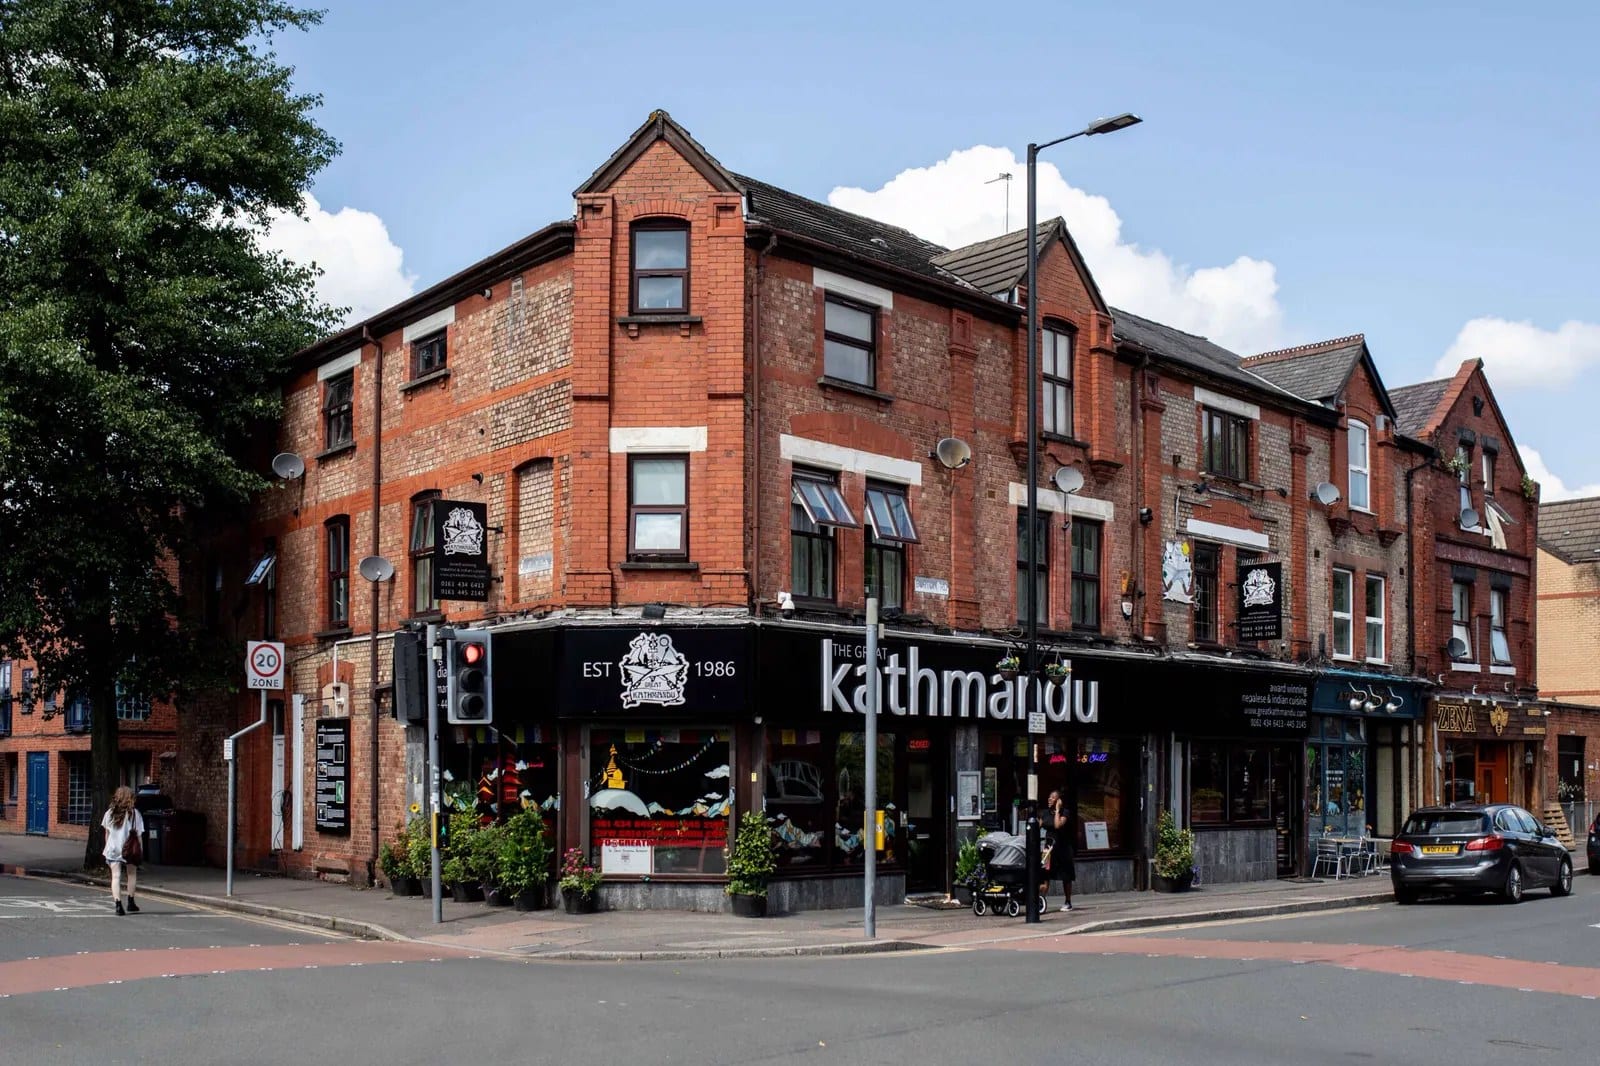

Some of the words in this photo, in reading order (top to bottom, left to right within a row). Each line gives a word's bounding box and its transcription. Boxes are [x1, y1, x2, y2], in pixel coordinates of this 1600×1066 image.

[832, 643, 852, 658] THE
[256, 653, 277, 668] 20
[583, 662, 613, 678] EST
[694, 661, 736, 677] 1986
[252, 678, 279, 688] ZONE
[821, 638, 1099, 723] kathmandu
[1270, 683, 1287, 693] award
[1287, 684, 1307, 697] winning
[1241, 692, 1267, 704] nepalese
[1267, 694, 1271, 703] &
[1272, 694, 1288, 704] indian
[1289, 695, 1307, 705] cuisine
[1263, 719, 1271, 727] 434
[1437, 703, 1477, 733] ZENA
